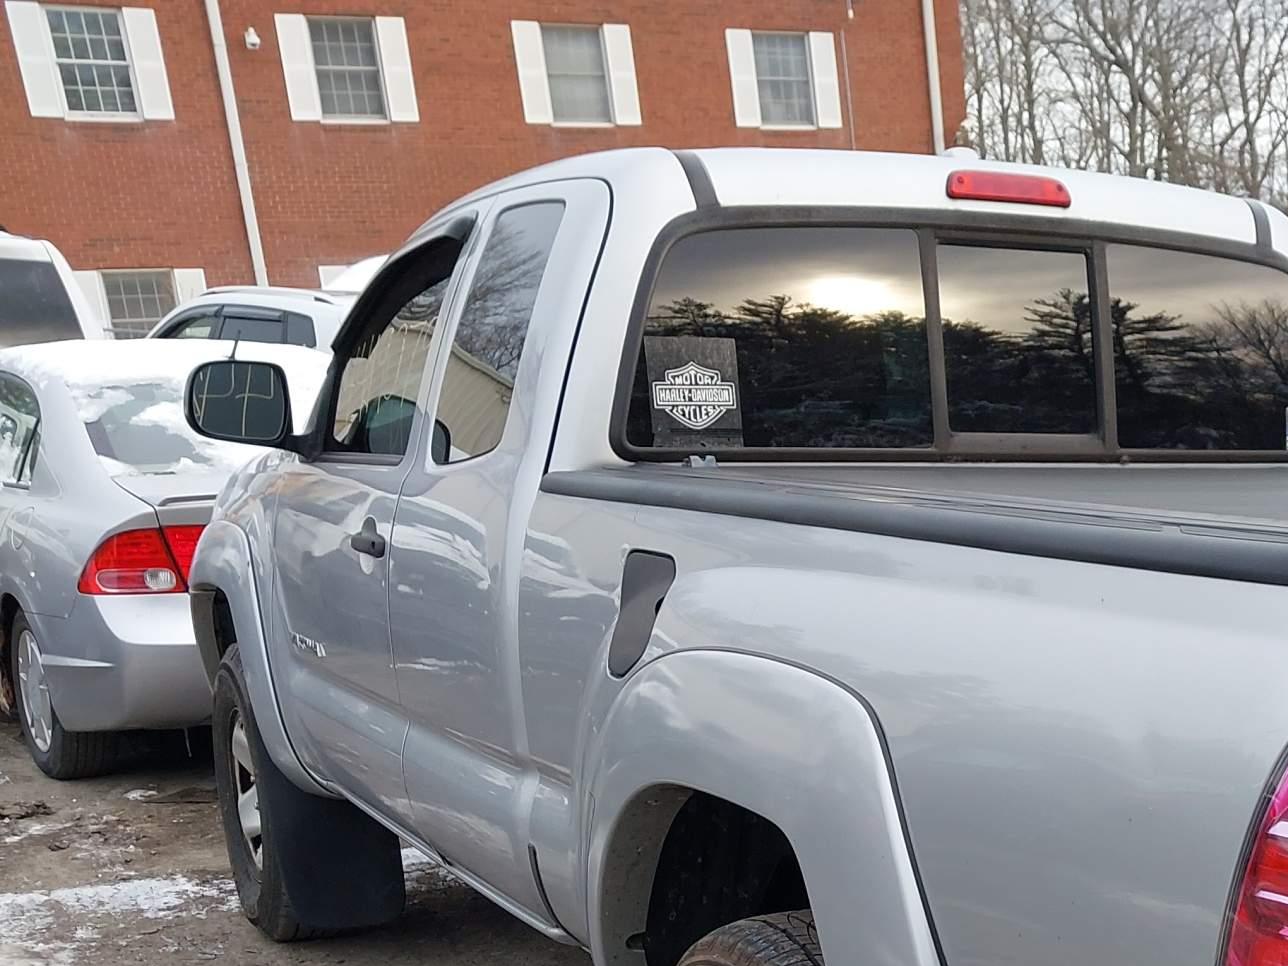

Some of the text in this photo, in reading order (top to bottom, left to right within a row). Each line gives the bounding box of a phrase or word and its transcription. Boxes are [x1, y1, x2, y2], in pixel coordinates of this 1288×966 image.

[674, 369, 712, 385] MOTOR
[659, 387, 730, 402] HARLEY-DAVIDSON
[677, 405, 714, 422] CYCLES
